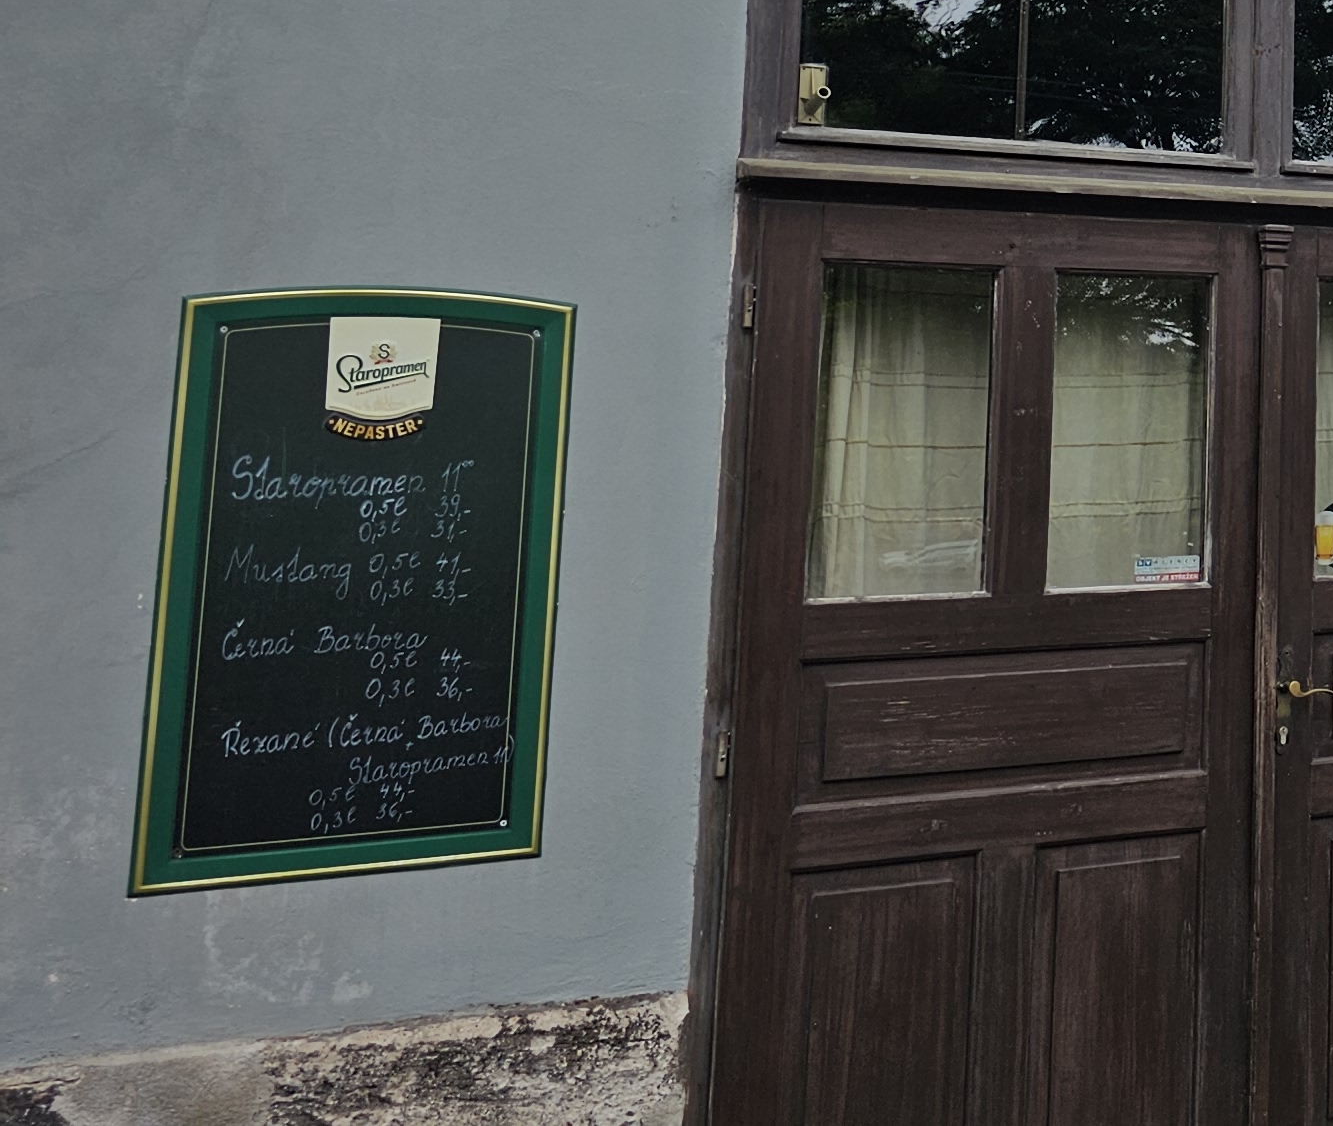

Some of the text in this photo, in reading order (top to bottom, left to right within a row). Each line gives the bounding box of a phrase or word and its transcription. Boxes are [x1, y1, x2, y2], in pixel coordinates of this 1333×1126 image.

[378, 343, 390, 359] S
[336, 354, 430, 393] Staropramen
[333, 418, 418, 440] NEPASTER
[232, 455, 426, 509] Staropramen
[224, 544, 352, 601] Mustang
[222, 618, 429, 661] Černá Barbora
[221, 720, 321, 757] Řezané
[417, 712, 508, 740] Barbora
[349, 749, 488, 787] Staropramen
